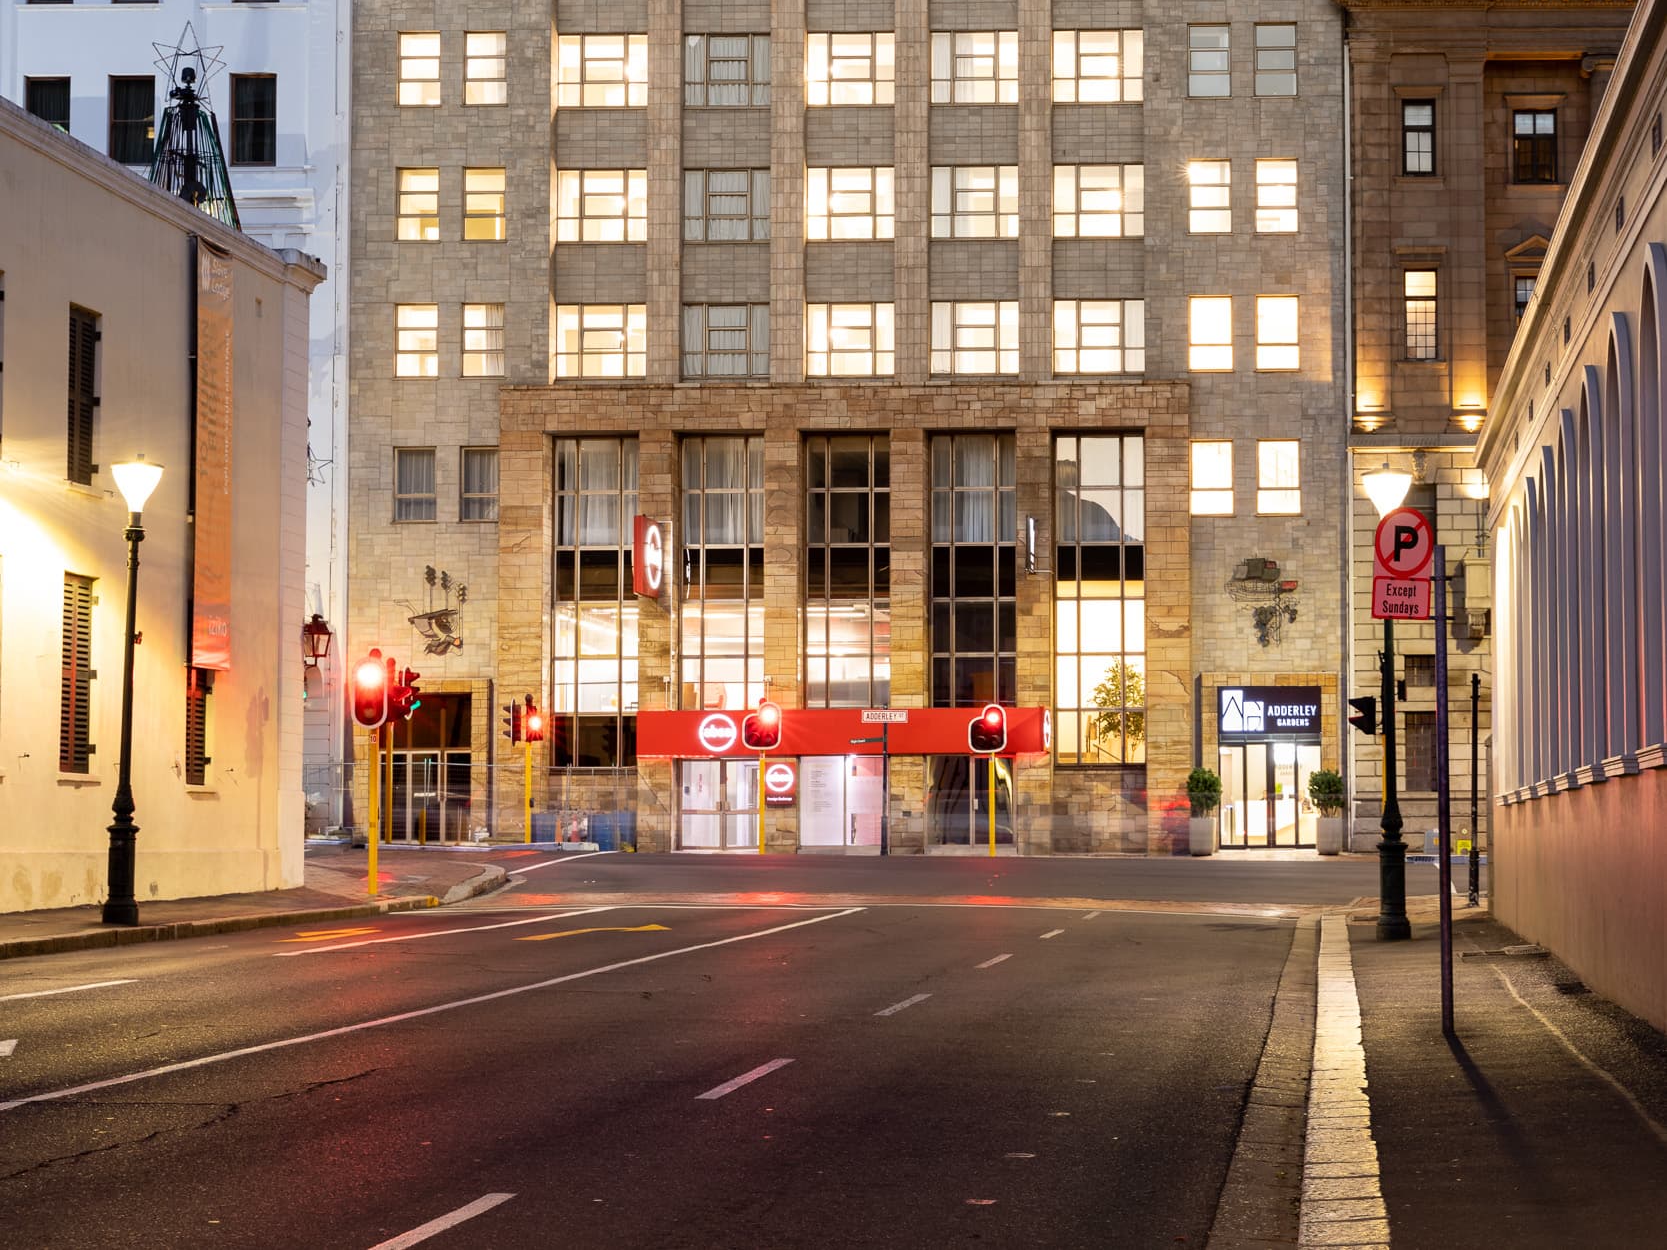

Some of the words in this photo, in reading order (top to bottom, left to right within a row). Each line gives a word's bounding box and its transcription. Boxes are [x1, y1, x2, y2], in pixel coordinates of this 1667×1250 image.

[1393, 525, 1418, 562] P
[1386, 583, 1417, 598] Except
[1382, 600, 1419, 615] Sundays
[1267, 705, 1317, 716] ADDERLEY
[1276, 718, 1310, 727] GARDENS
